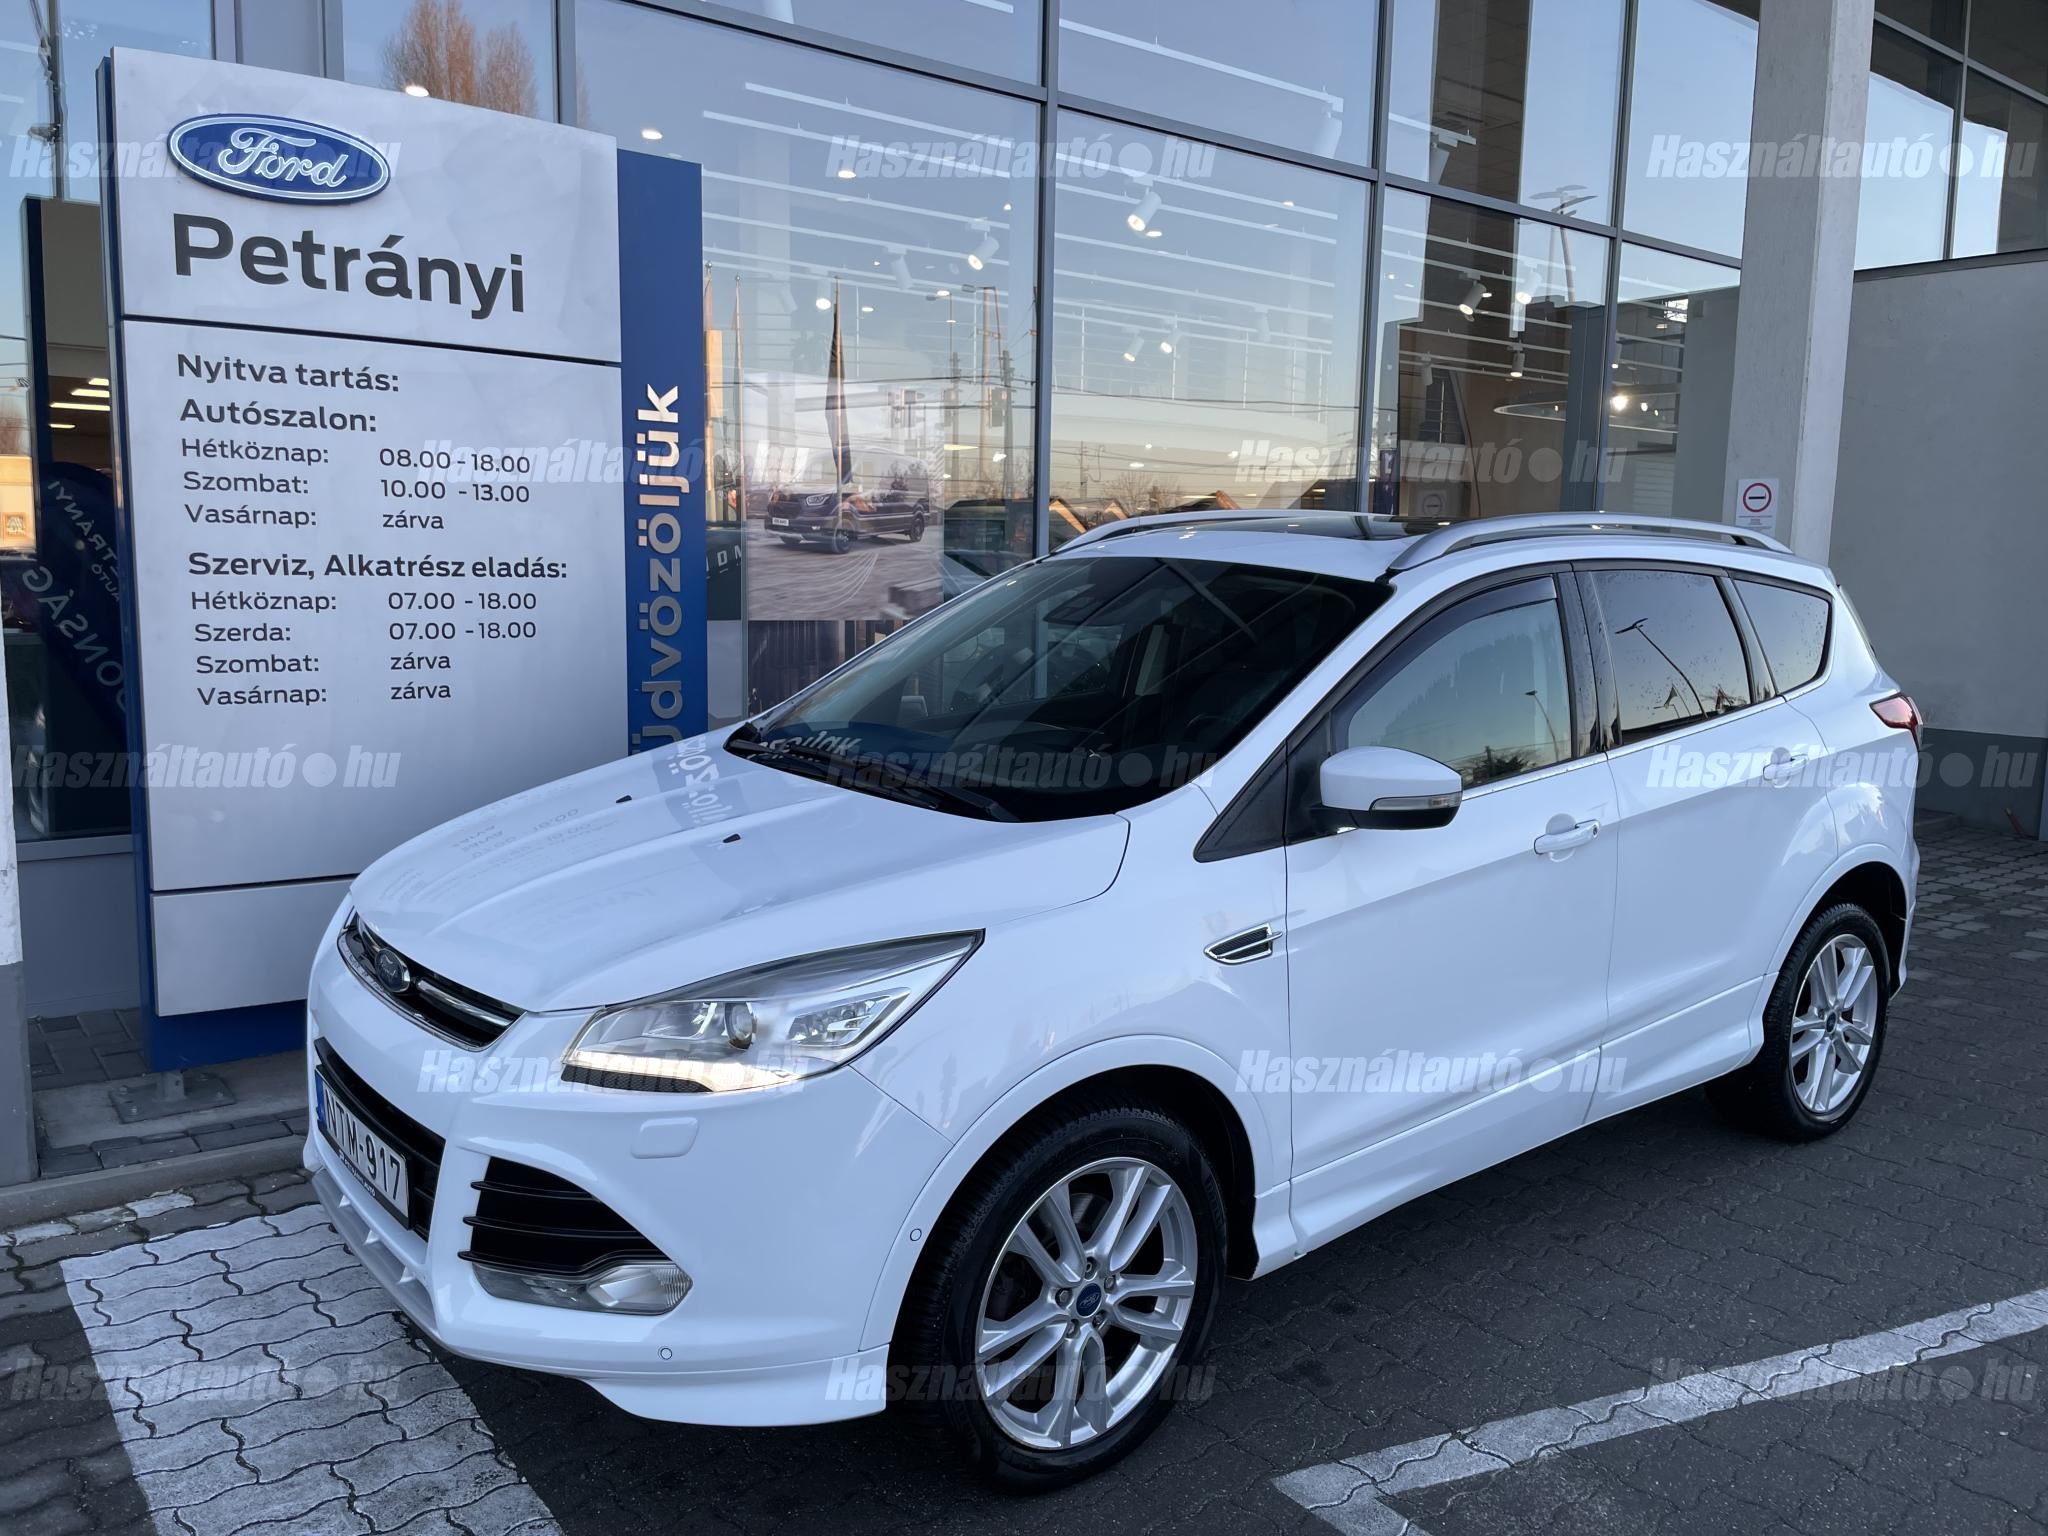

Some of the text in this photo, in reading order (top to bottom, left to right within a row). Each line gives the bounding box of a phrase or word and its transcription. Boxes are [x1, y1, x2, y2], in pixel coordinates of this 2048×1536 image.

[217, 127, 349, 188] Ford
[172, 213, 526, 321] Petrányi
[177, 353, 399, 392] Nyitva tartás:
[179, 398, 377, 432] Autószalon:
[181, 438, 329, 466] Hétköznap:
[183, 471, 309, 494] Szombat:
[184, 503, 445, 530] Vasárnap: zárva
[188, 552, 567, 581] Szerviz, Alkatrész eladás:
[191, 590, 337, 614] Hétköznap:
[194, 622, 291, 642] Szerda:
[196, 651, 451, 674] Szombat: zárva
[196, 681, 452, 706] Vasárnap: zárva
[325, 1088, 402, 1200] NTM-917
